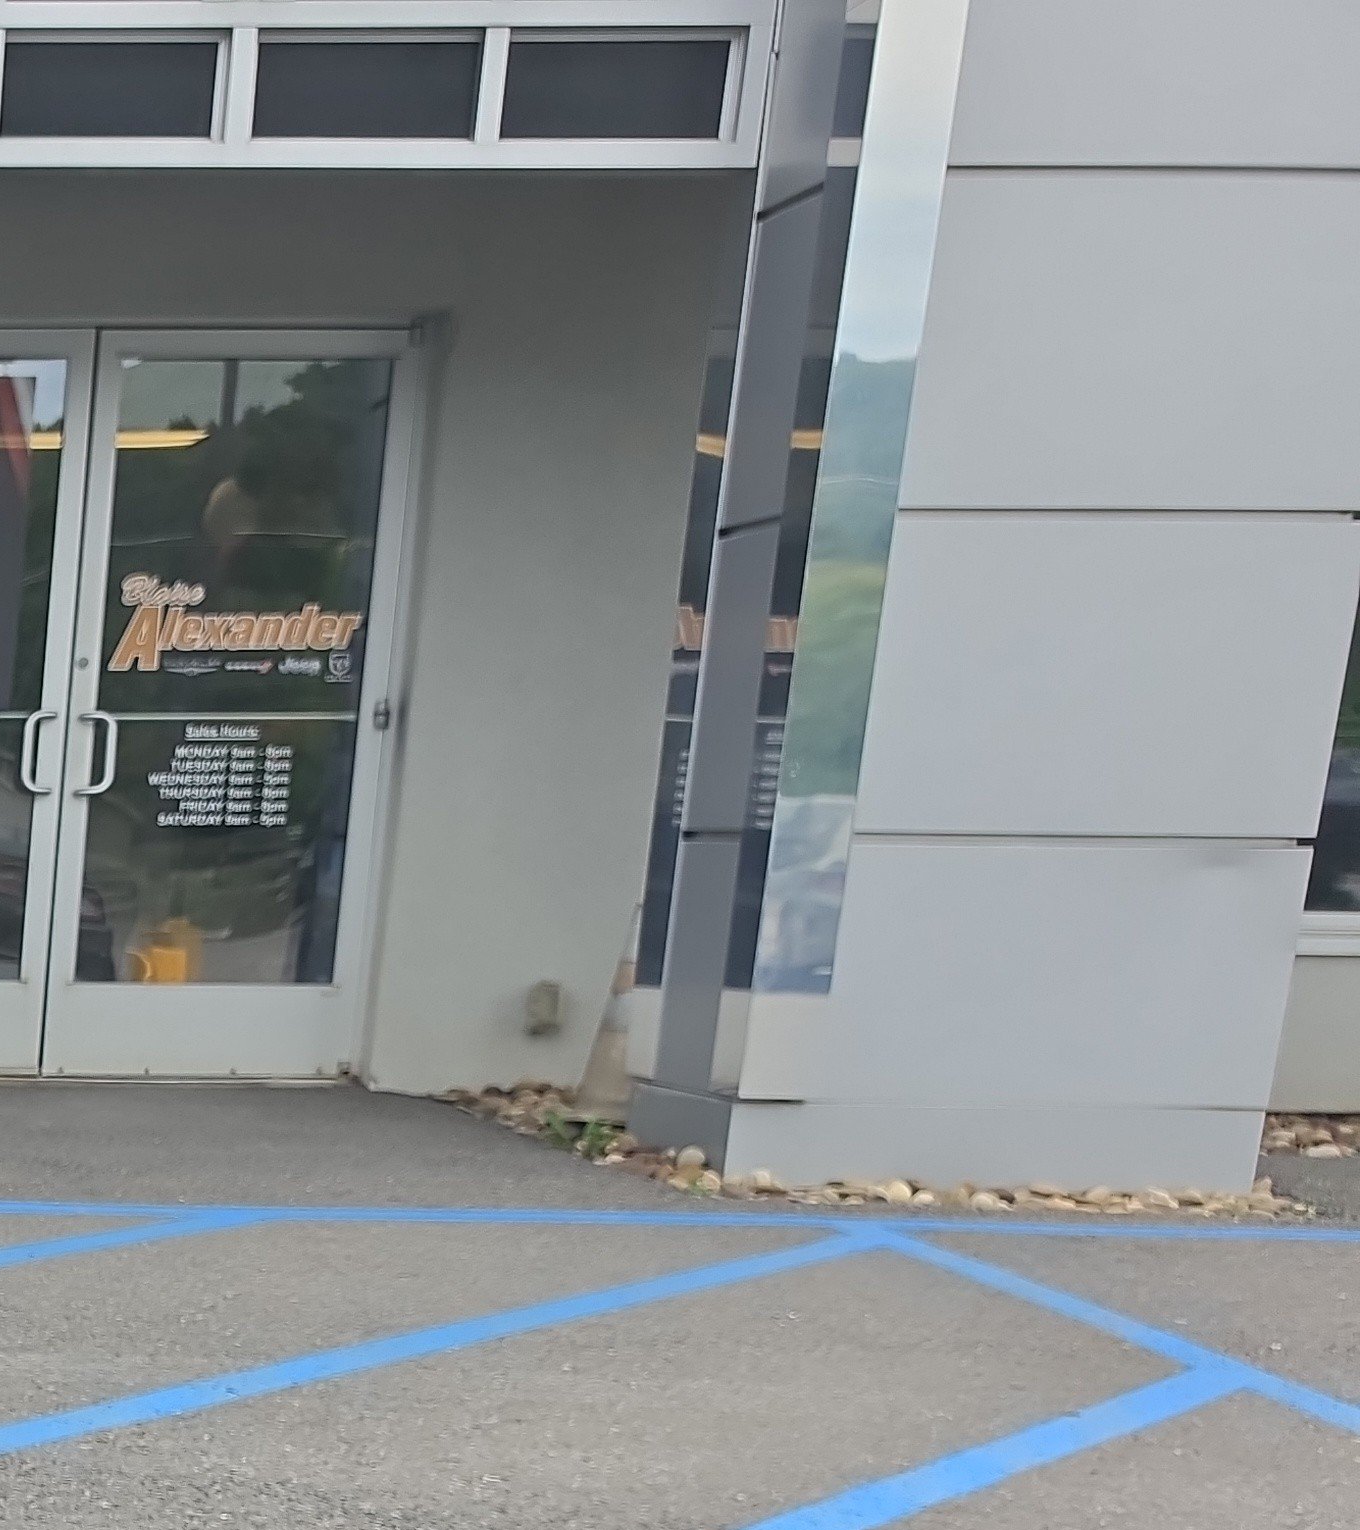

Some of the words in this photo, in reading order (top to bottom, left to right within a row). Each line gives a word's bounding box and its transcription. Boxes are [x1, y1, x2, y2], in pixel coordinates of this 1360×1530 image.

[107, 602, 363, 671] Alexander
[174, 744, 229, 758] MONDAY
[170, 758, 228, 772] TUESDAY
[148, 772, 227, 786] WEDNESDAY
[159, 786, 225, 799] THURSDAY
[179, 799, 224, 812] FRIDAY
[156, 812, 223, 826] SATURDAY
